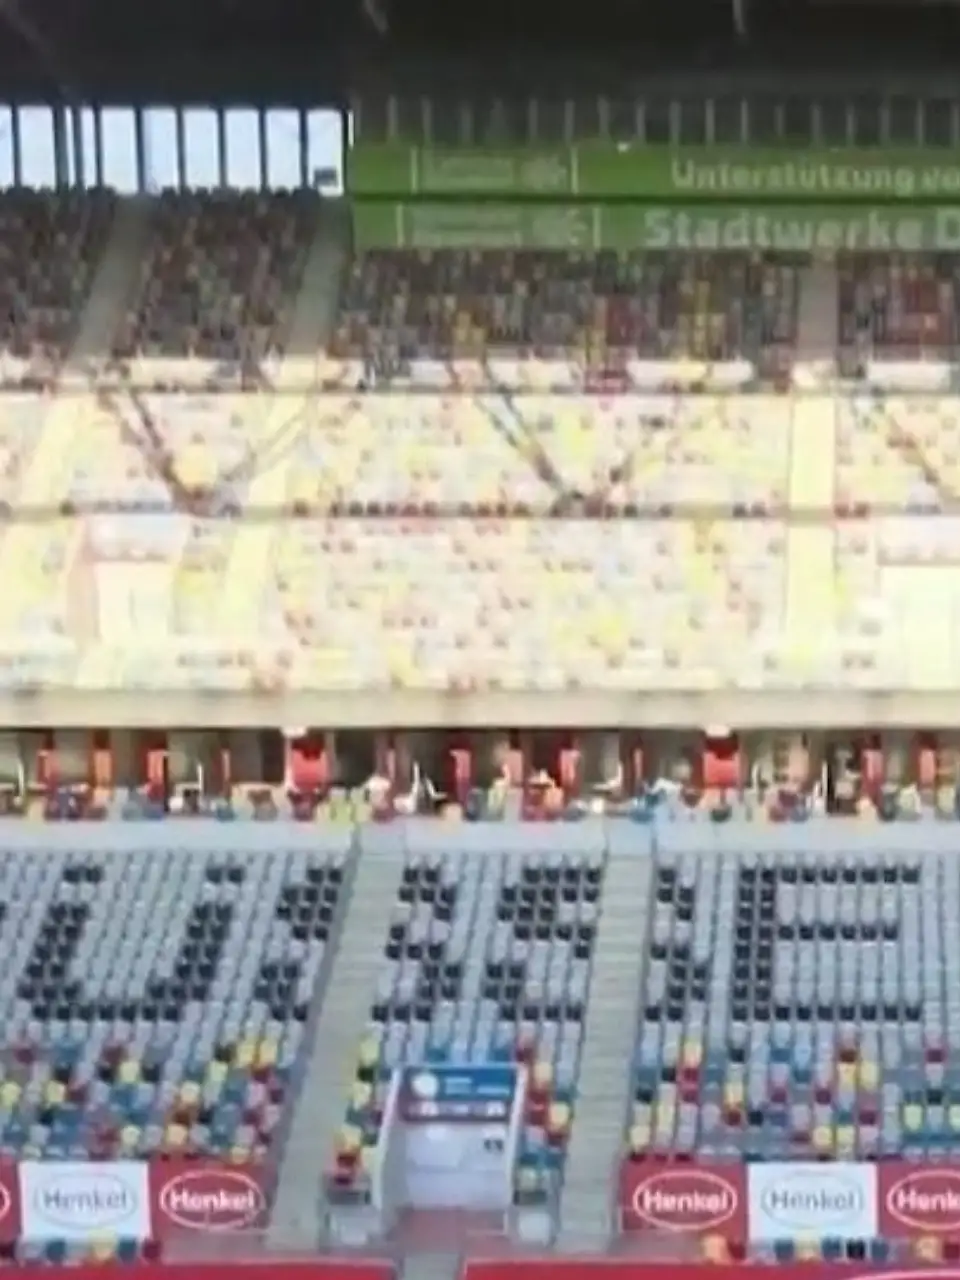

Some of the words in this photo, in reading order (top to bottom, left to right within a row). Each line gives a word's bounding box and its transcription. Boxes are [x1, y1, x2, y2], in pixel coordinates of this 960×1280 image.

[644, 209, 922, 248] Stadtwerke
[169, 1187, 255, 1213] Henkel
[641, 1188, 728, 1213] Henkel
[769, 1187, 859, 1213] Henkel
